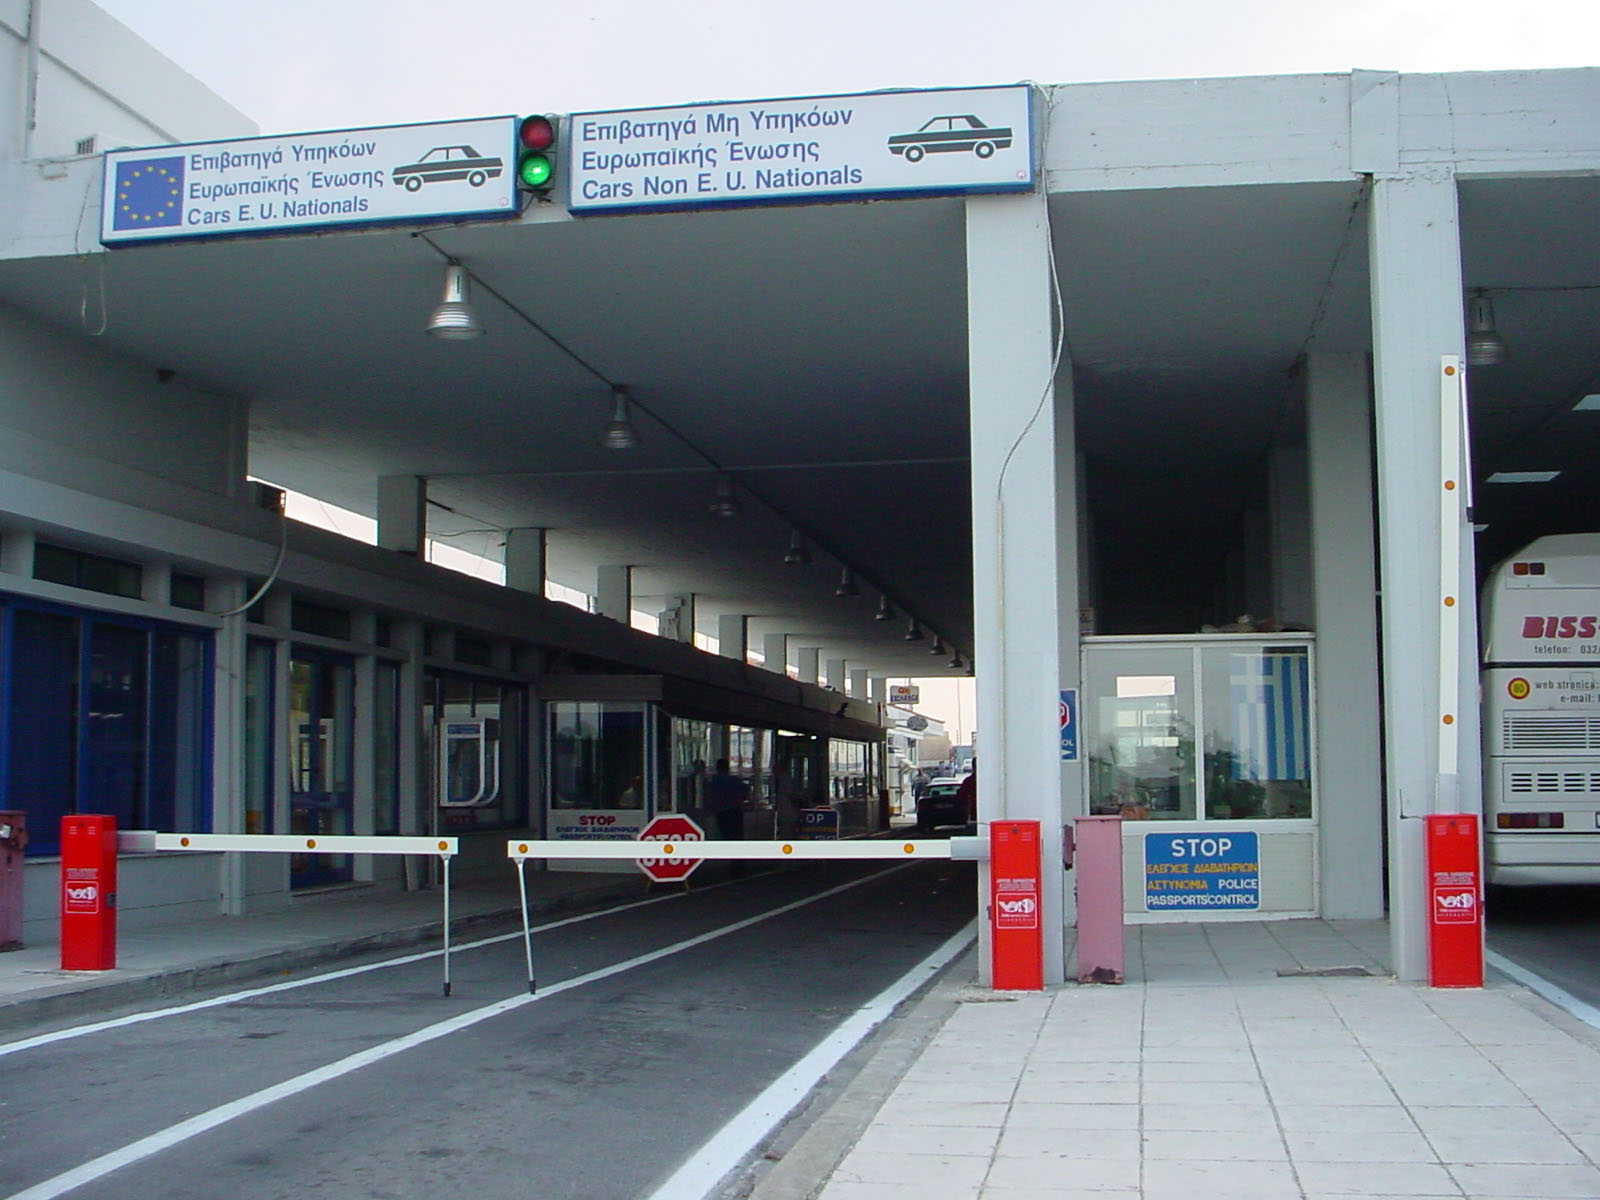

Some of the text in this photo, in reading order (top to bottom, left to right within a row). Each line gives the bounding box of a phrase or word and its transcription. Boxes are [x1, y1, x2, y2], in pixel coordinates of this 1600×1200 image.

[583, 104, 853, 144] Επιβατηγά Μη Υπηκόων
[190, 139, 377, 174] Επιβατηγά Υπηκόων
[582, 140, 820, 174] Ευρωπαϊκής Ένωσης
[189, 169, 384, 201] Ευρωπαϊκής Ένωσης
[582, 179, 634, 200] Cars
[643, 175, 688, 195] Non
[755, 165, 863, 189] Nationals
[187, 207, 231, 225] Cars
[282, 196, 370, 218] Nationals
[1522, 616, 1600, 638] BISS
[1580, 644, 1600, 654] 032
[1535, 680, 1554, 689] web
[1560, 694, 1595, 703] e-mail:
[579, 815, 616, 826] STOP
[1171, 838, 1232, 857] STOP
[1218, 878, 1258, 890] POLICE
